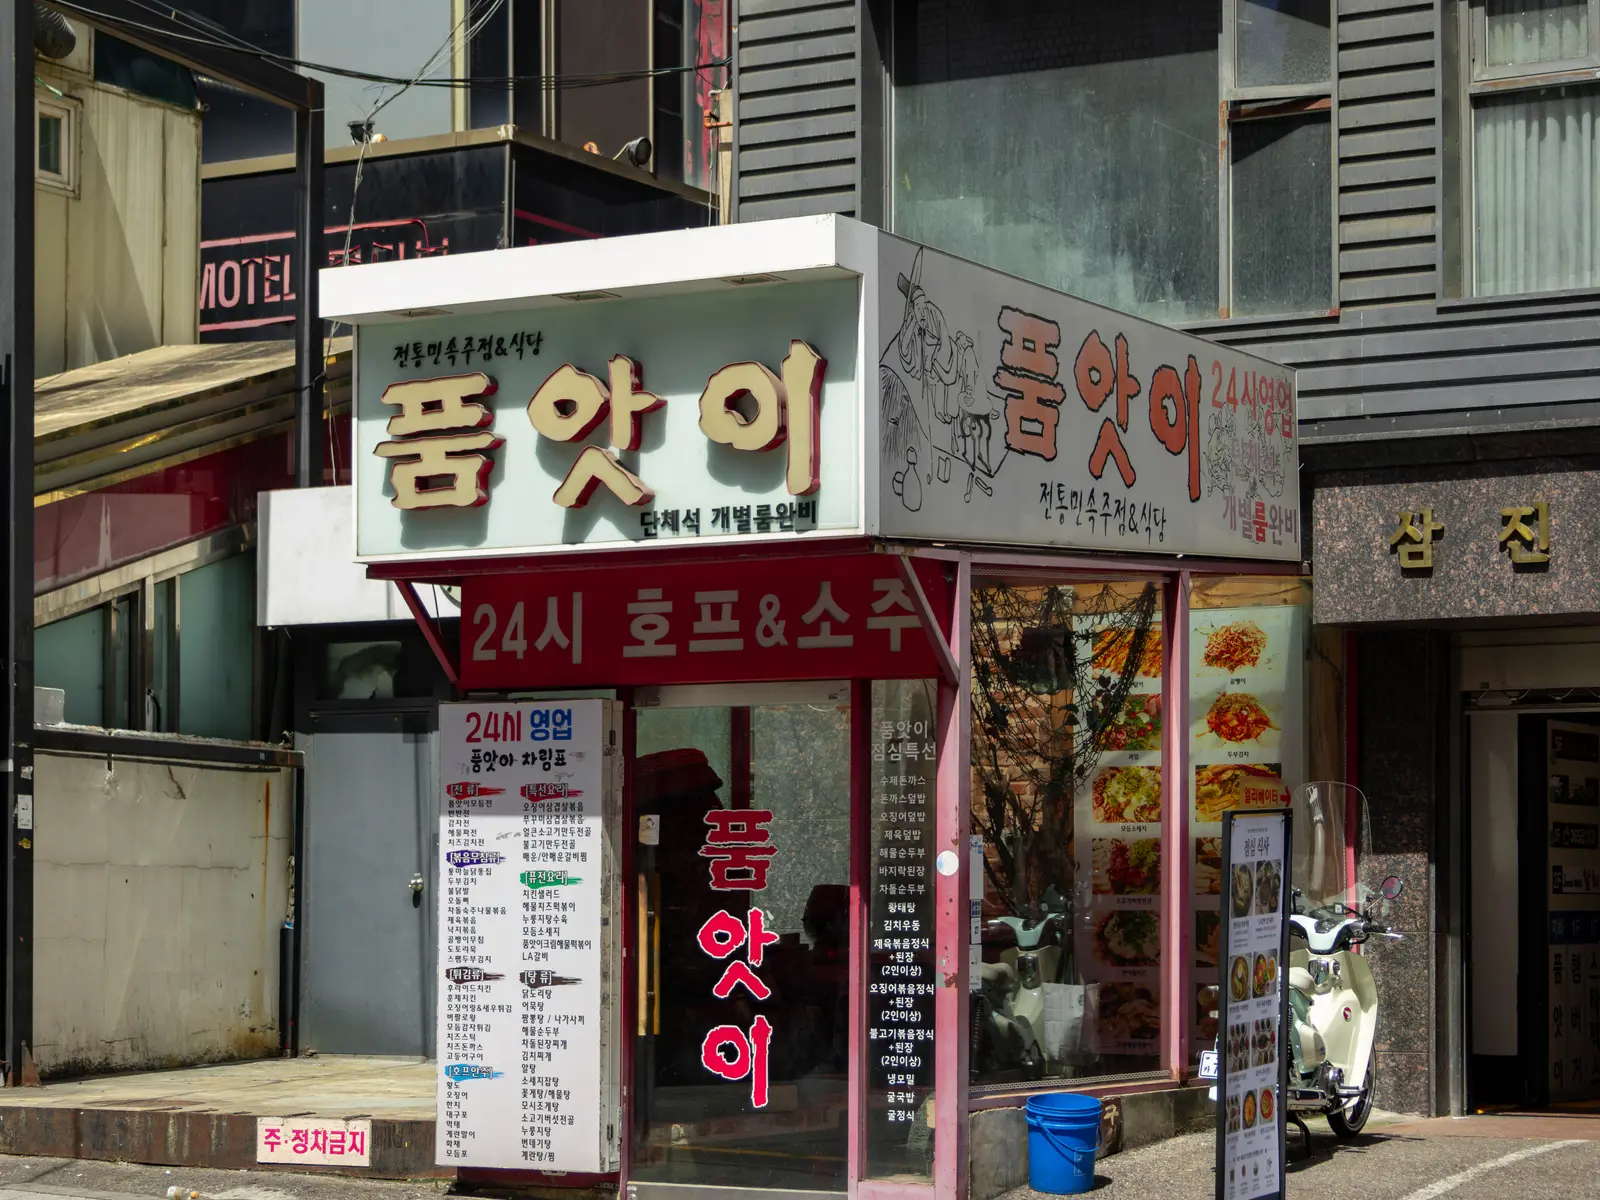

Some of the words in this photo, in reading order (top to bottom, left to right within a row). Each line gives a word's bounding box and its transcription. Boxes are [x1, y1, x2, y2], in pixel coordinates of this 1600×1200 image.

[393, 331, 543, 368] 전통민속주점&식당
[993, 306, 1200, 502] 품앗이
[1211, 359, 1293, 438] 24시영업
[373, 339, 827, 510] 품앗이
[640, 508, 701, 537] 단체석
[711, 501, 816, 531] 개별룸완비
[1040, 482, 1167, 545] 전통민속주점&식당
[1223, 495, 1297, 545] 개별룸완비
[473, 592, 583, 665] 24시
[623, 578, 923, 658] 호프&소주
[466, 711, 521, 743] 24시
[530, 709, 572, 741] 영업
[881, 720, 928, 739] 품앗이
[872, 741, 936, 761] 점심특선
[471, 749, 514, 773] 품앗이
[522, 748, 566, 771] 차림표
[880, 776, 925, 786] 수제돈까스
[526, 783, 568, 799] [특선요리]
[1244, 787, 1278, 805] 엘리베이터
[880, 794, 926, 803] 돈까스덮밥
[523, 802, 583, 812] 오징어삼겹살볶음
[880, 812, 925, 821] 오징어덮밥
[523, 828, 591, 837] 얼큰소고기만두전골
[884, 830, 921, 840] 제육덮밥
[523, 840, 576, 849] 불고기만두전골
[1244, 838, 1255, 858] 점심
[1257, 837, 1269, 856] 식사
[523, 852, 587, 862] 매운/안매운갈비찜
[880, 848, 925, 858] 해물순두부
[880, 866, 925, 876] 바지락된장
[525, 871, 568, 885] [퓨전요리]
[523, 890, 560, 899] 치킨샐러드
[879, 884, 925, 895] 차돌순두부
[523, 902, 576, 911] 해물치즈떡볶이
[888, 902, 916, 913] 황태탕
[523, 914, 568, 924] 누룽지탕수육
[448, 926, 476, 934] 낙지볶음
[884, 920, 920, 931] 김치우동
[523, 927, 560, 936] 모듬소세지
[523, 939, 591, 950] 품앗이크림해물떡볶이
[874, 938, 929, 949] 제육볶음정식
[523, 952, 548, 961] LA갈비
[697, 809, 779, 1107] 품앗이
[890, 952, 914, 962] +된장
[450, 969, 484, 981] [튀김류]
[882, 965, 922, 976] (2인이상)
[522, 989, 552, 999] 닭도리탕
[870, 984, 934, 994] 오징어볶음정식
[522, 1002, 544, 1012] 어묵탕
[889, 997, 913, 1007] +된장
[447, 1004, 512, 1012] 오징어링&새우튀김
[447, 1014, 476, 1022] 버팔로윙
[522, 1014, 544, 1024] 짬뽕탕
[555, 1015, 585, 1025] 나가사끼
[882, 1010, 921, 1021] (2인이상)
[447, 1024, 491, 1032] 모듬감자튀김
[522, 1027, 559, 1036] 해물순두부
[447, 1033, 476, 1041] 치즈스틱
[870, 1028, 934, 1040] 불고기볶음정식
[447, 1043, 483, 1051] 치즈돈까스
[522, 1039, 568, 1049] 차돌된장찌개
[889, 1042, 913, 1053] +된장
[522, 1052, 552, 1061] 김치찌개
[882, 1056, 921, 1067] (2인이상)
[448, 1066, 493, 1079] [호프안주]
[522, 1064, 536, 1073] 알탕
[522, 1077, 559, 1087] 소세지잡탕
[888, 1074, 914, 1085] 냉모밀
[522, 1088, 571, 1100] 꽃게탕/해물탕
[887, 1092, 914, 1103] 굴국밥
[446, 1111, 467, 1119] 대구포
[522, 1113, 574, 1125] 소고기버섯전골
[888, 1110, 914, 1121] 굴정식
[446, 1131, 475, 1139] 계란말이
[522, 1126, 551, 1137] 누룽지탕
[522, 1138, 551, 1149] 번데기탕
[446, 1150, 468, 1158] 모듬포
[522, 1151, 555, 1162] 계란탕/찜
